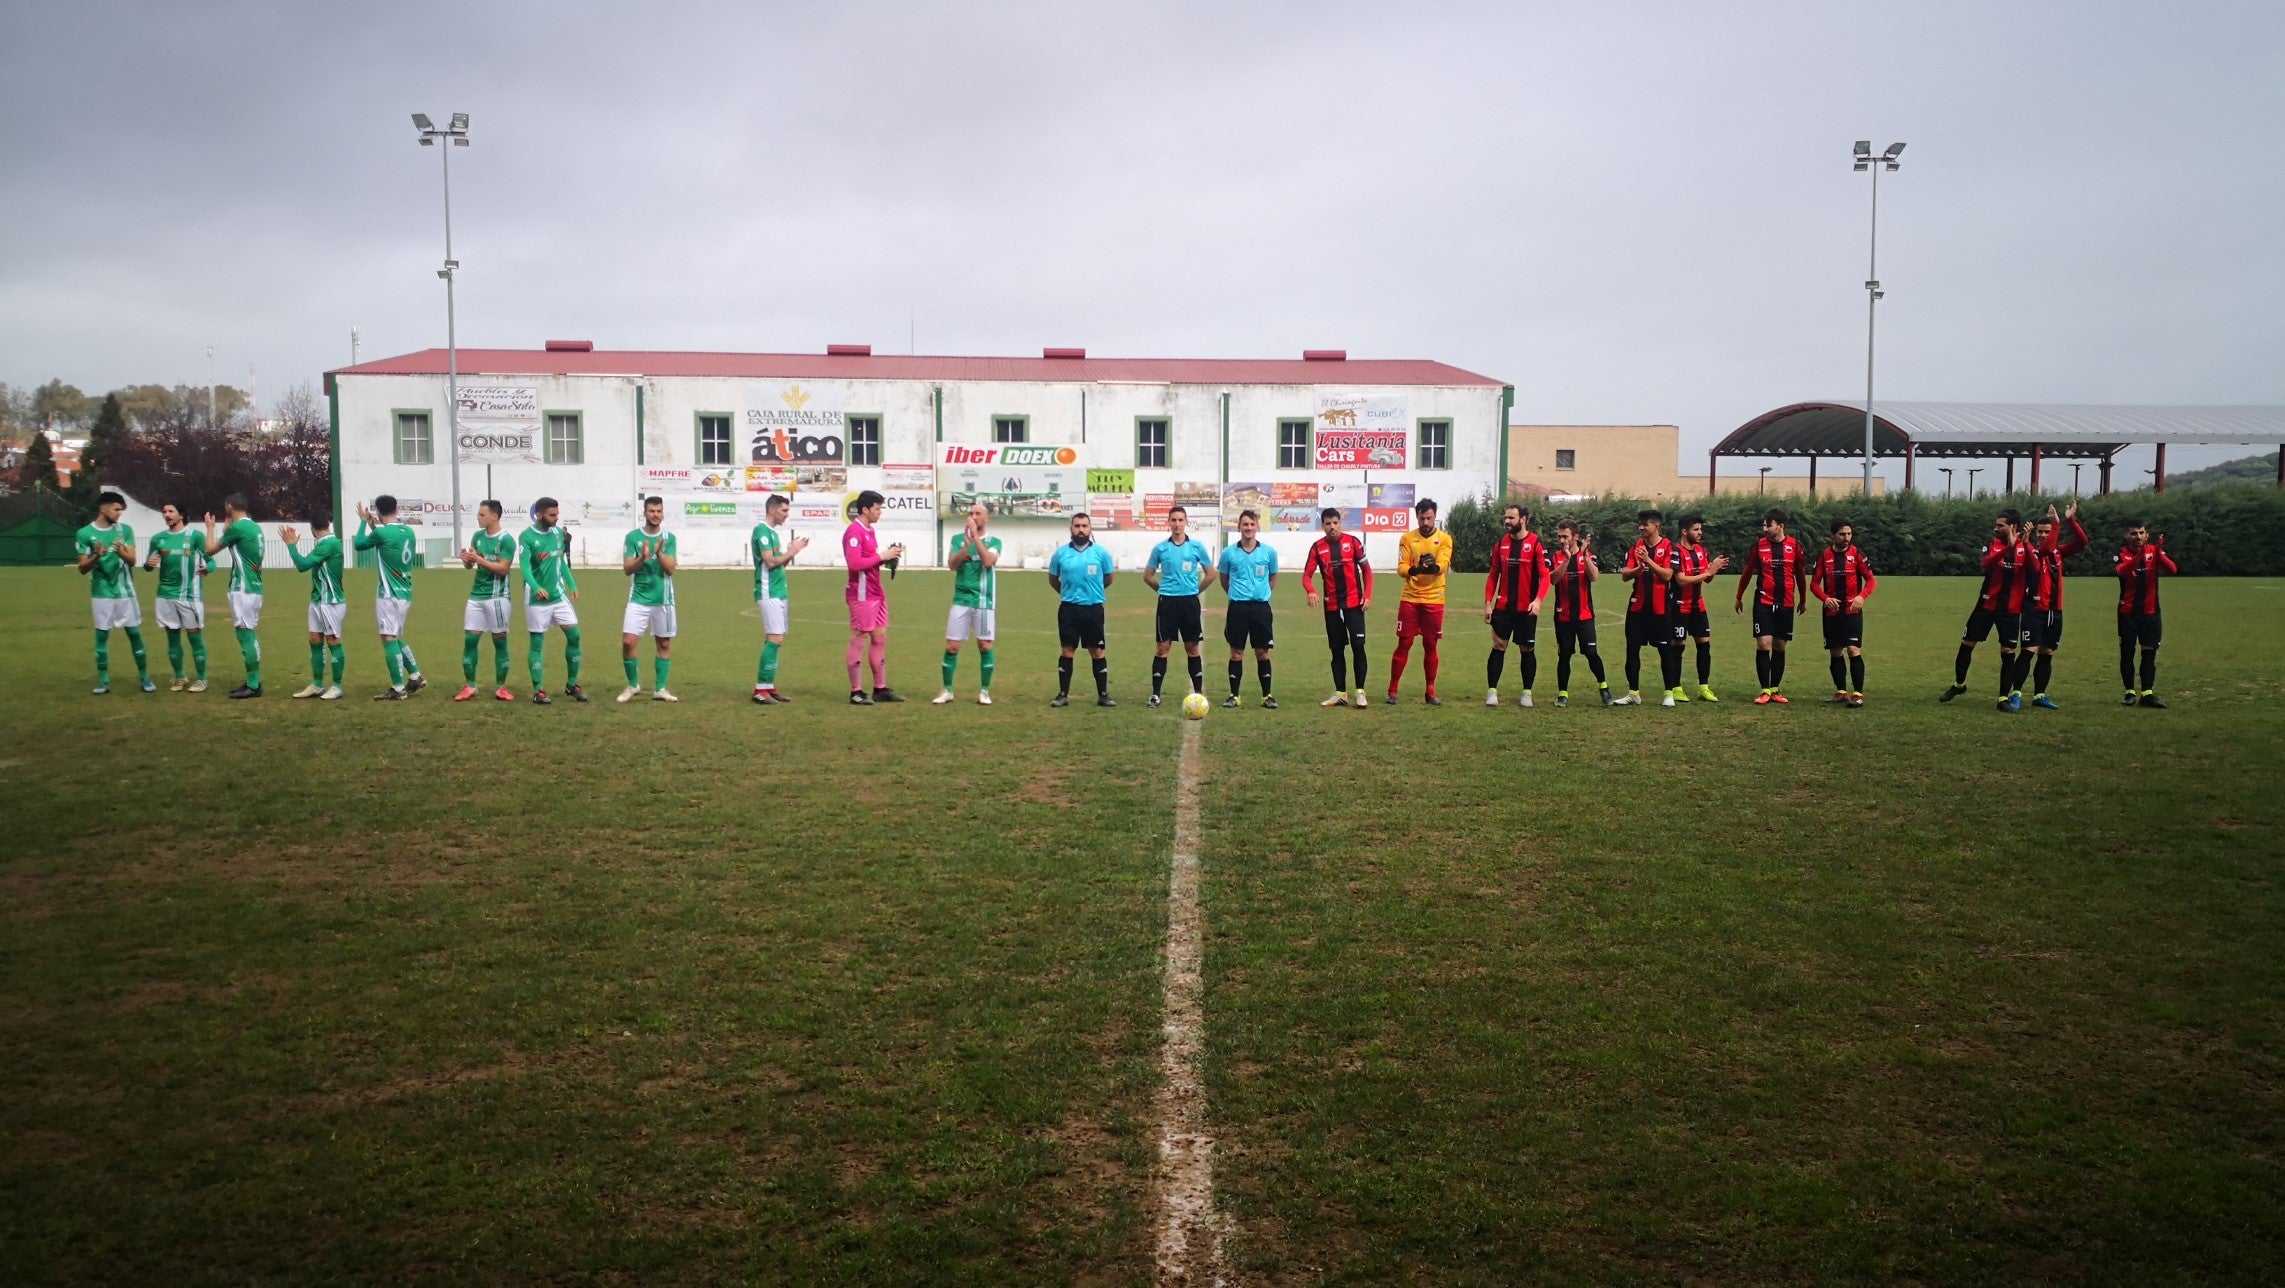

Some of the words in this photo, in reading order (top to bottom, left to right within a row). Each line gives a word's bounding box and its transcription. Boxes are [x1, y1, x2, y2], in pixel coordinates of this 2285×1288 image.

[747, 409, 774, 418] CAJA
[778, 410, 817, 419] RURAL
[459, 434, 533, 449] CONDE
[752, 427, 844, 461] ático
[1317, 432, 1406, 450] Lusitania
[945, 446, 998, 464] iber
[1005, 449, 1055, 464] DOEX
[1316, 447, 1355, 462] Cars
[649, 470, 691, 478] MAPFRE
[402, 539, 412, 564] 6
[1754, 623, 1761, 634] 8
[2022, 630, 2031, 641] 12
